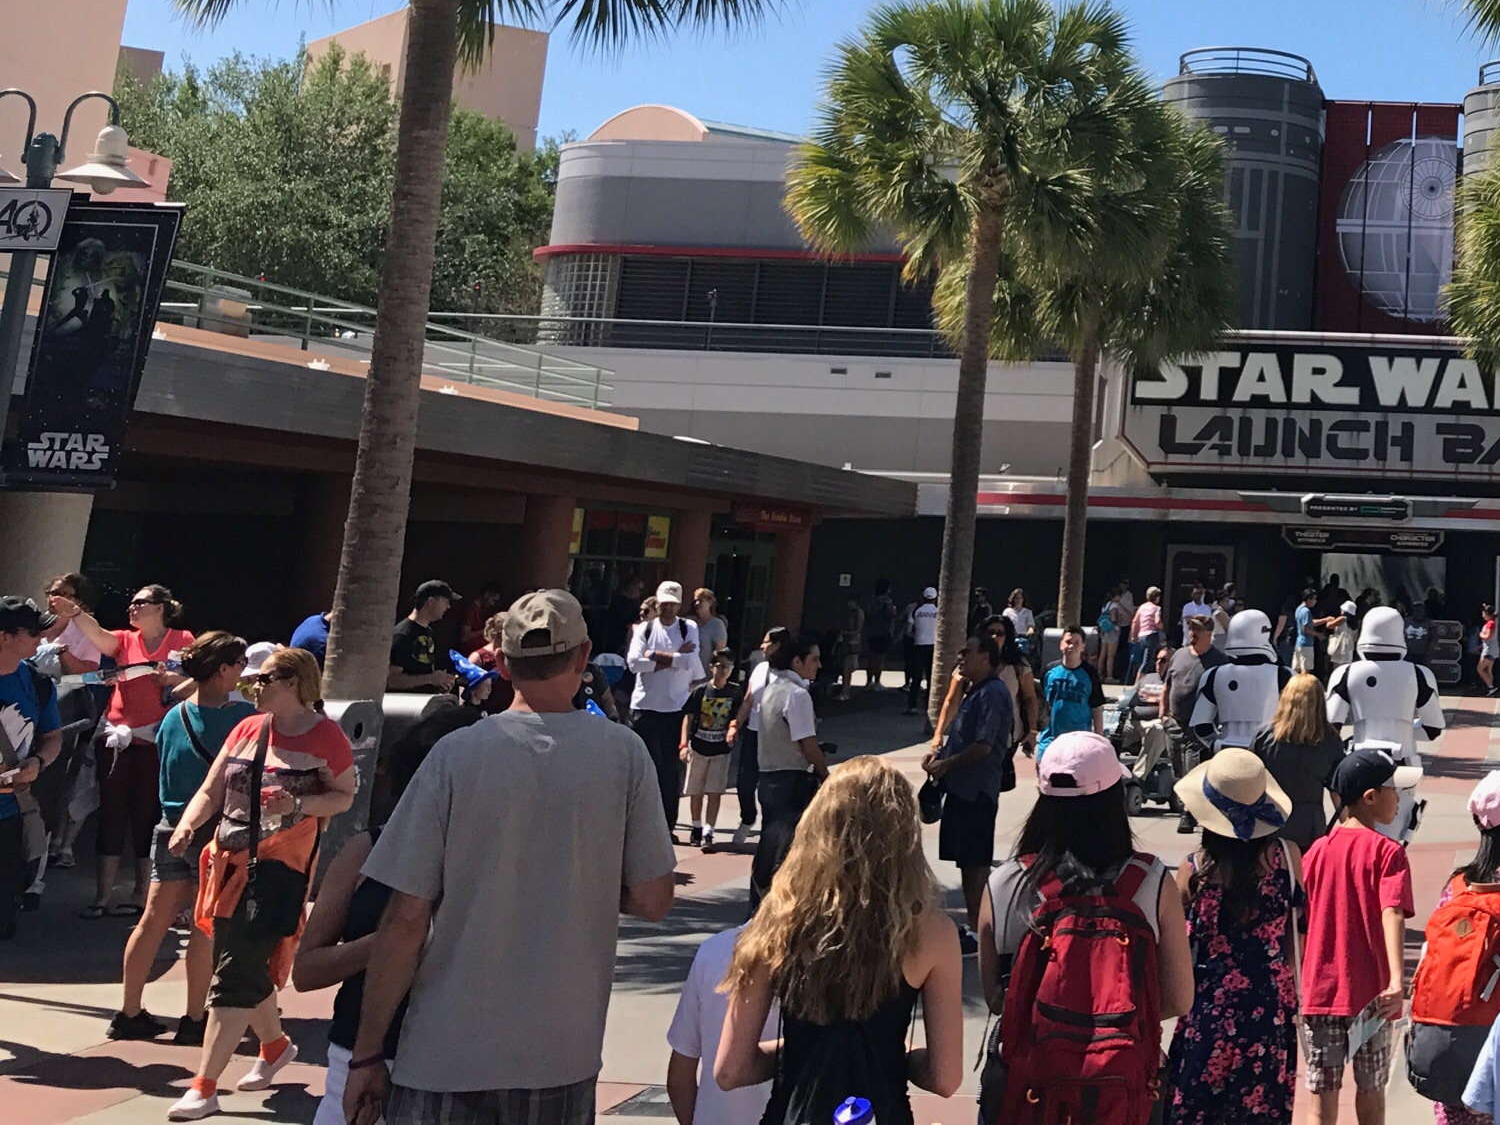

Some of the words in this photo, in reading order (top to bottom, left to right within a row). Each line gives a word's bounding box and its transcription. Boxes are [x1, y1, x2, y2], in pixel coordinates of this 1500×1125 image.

[1135, 351, 1361, 405] STAR
[27, 432, 110, 453] STAR
[1158, 413, 1415, 462] LAUNCH
[27, 449, 110, 470] WARS
